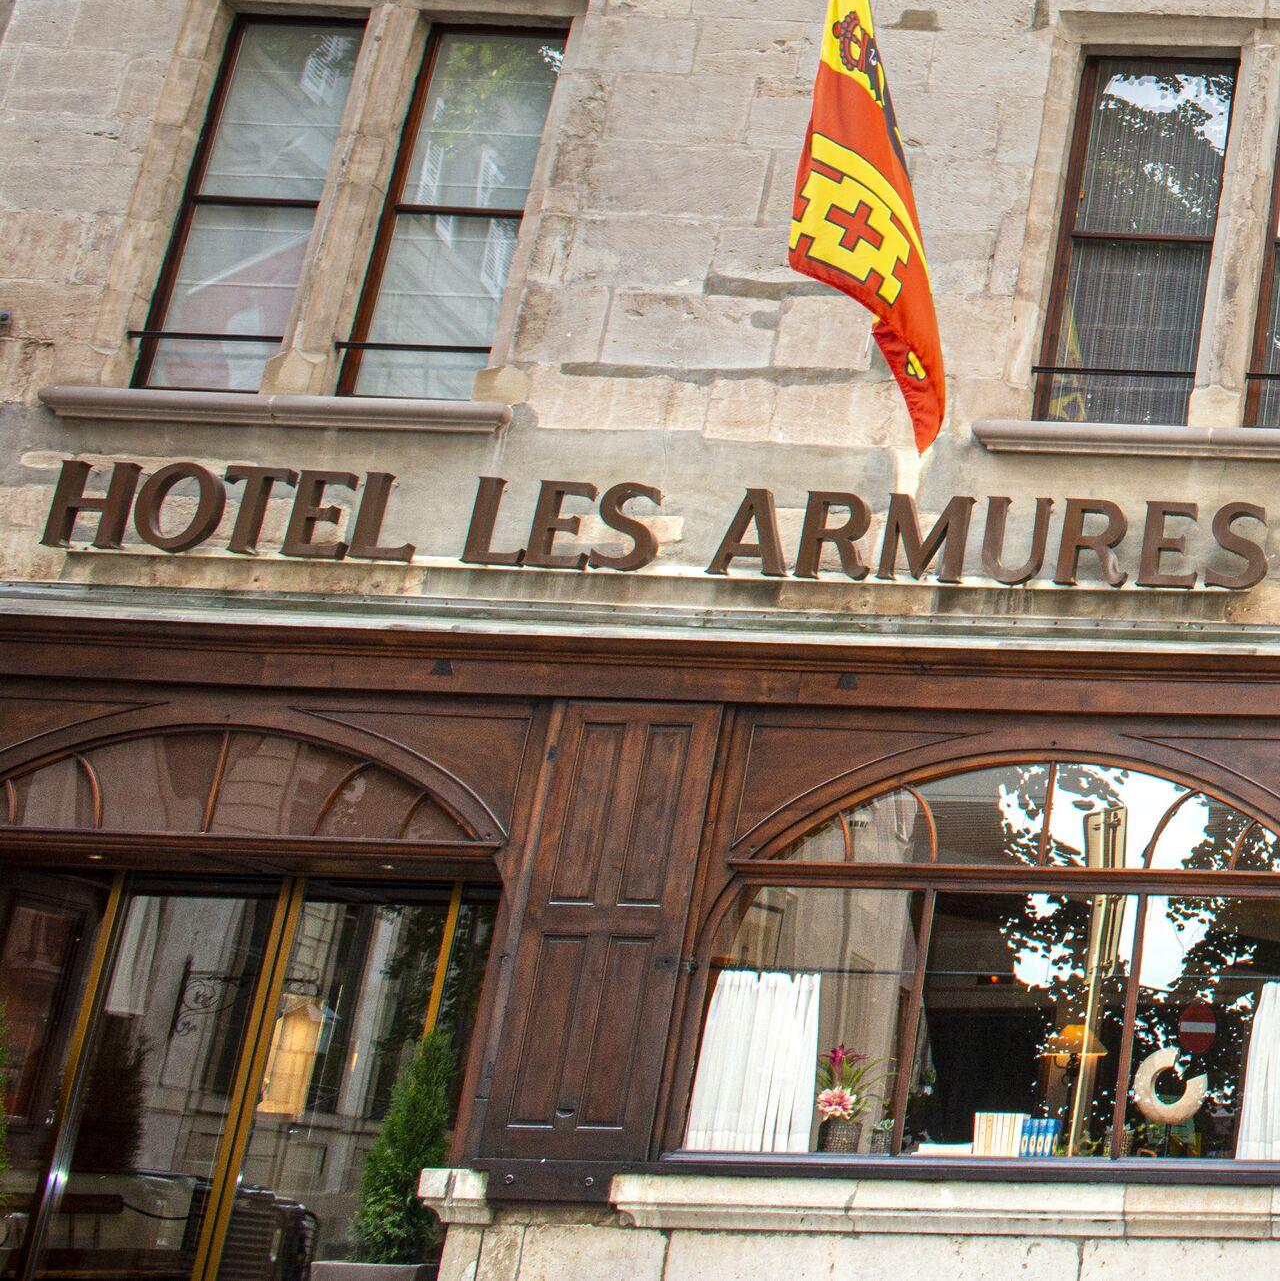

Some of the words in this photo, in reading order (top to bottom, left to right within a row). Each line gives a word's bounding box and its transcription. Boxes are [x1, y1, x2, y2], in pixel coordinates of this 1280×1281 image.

[40, 460, 415, 563] HOTEL
[460, 476, 663, 571] LES
[705, 488, 1268, 590] ARMURES
